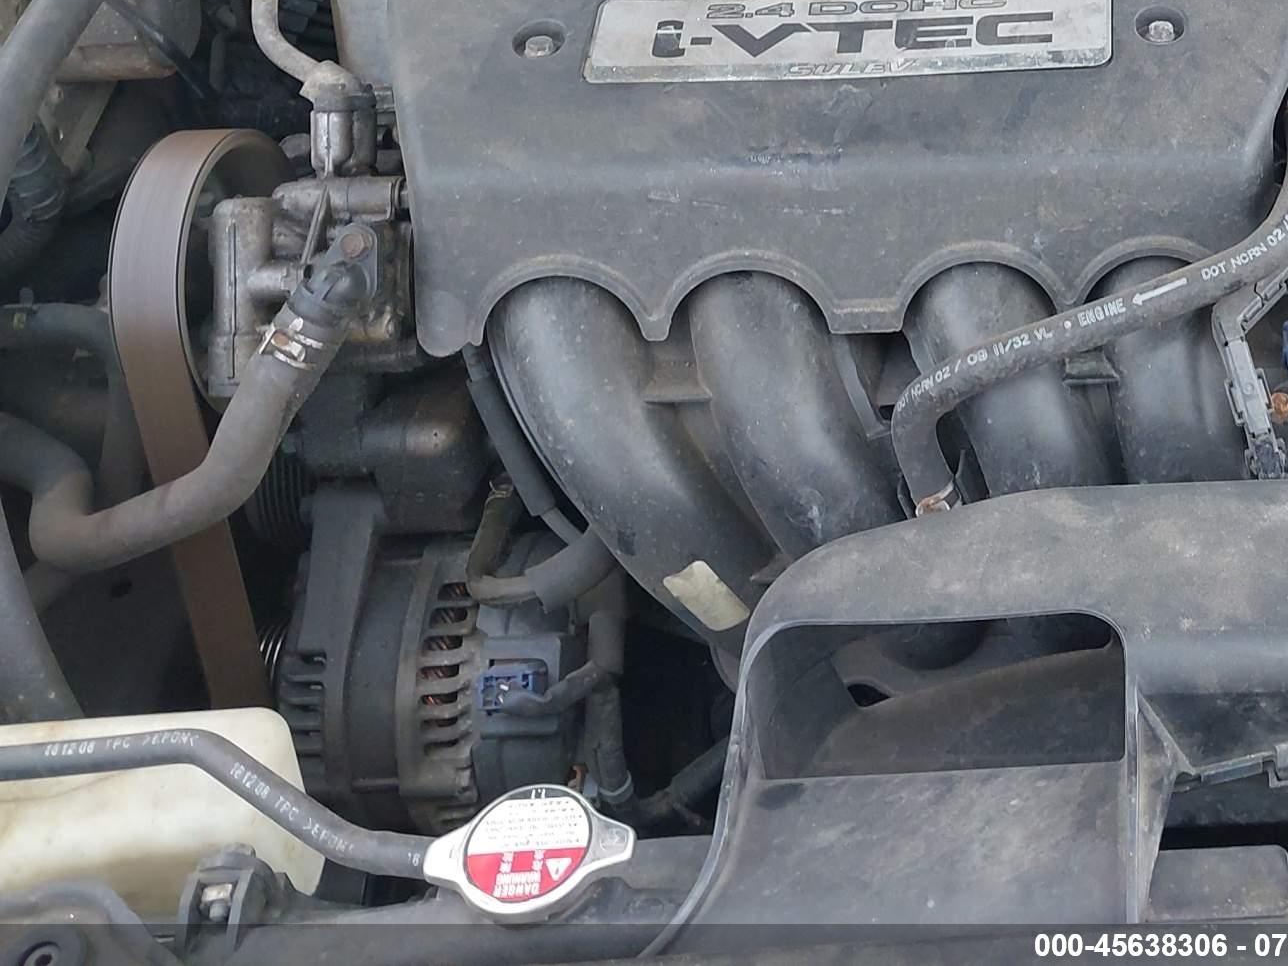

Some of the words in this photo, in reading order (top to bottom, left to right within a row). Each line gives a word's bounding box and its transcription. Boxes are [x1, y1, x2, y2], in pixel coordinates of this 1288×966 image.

[706, 1, 795, 18] 2.4
[784, 58, 918, 78] SULEV
[1201, 261, 1227, 281] DOT
[1077, 298, 1127, 327] ENGINE
[274, 796, 299, 821] TPC
[495, 871, 541, 886] WARNING
[492, 883, 540, 898] DANGER
